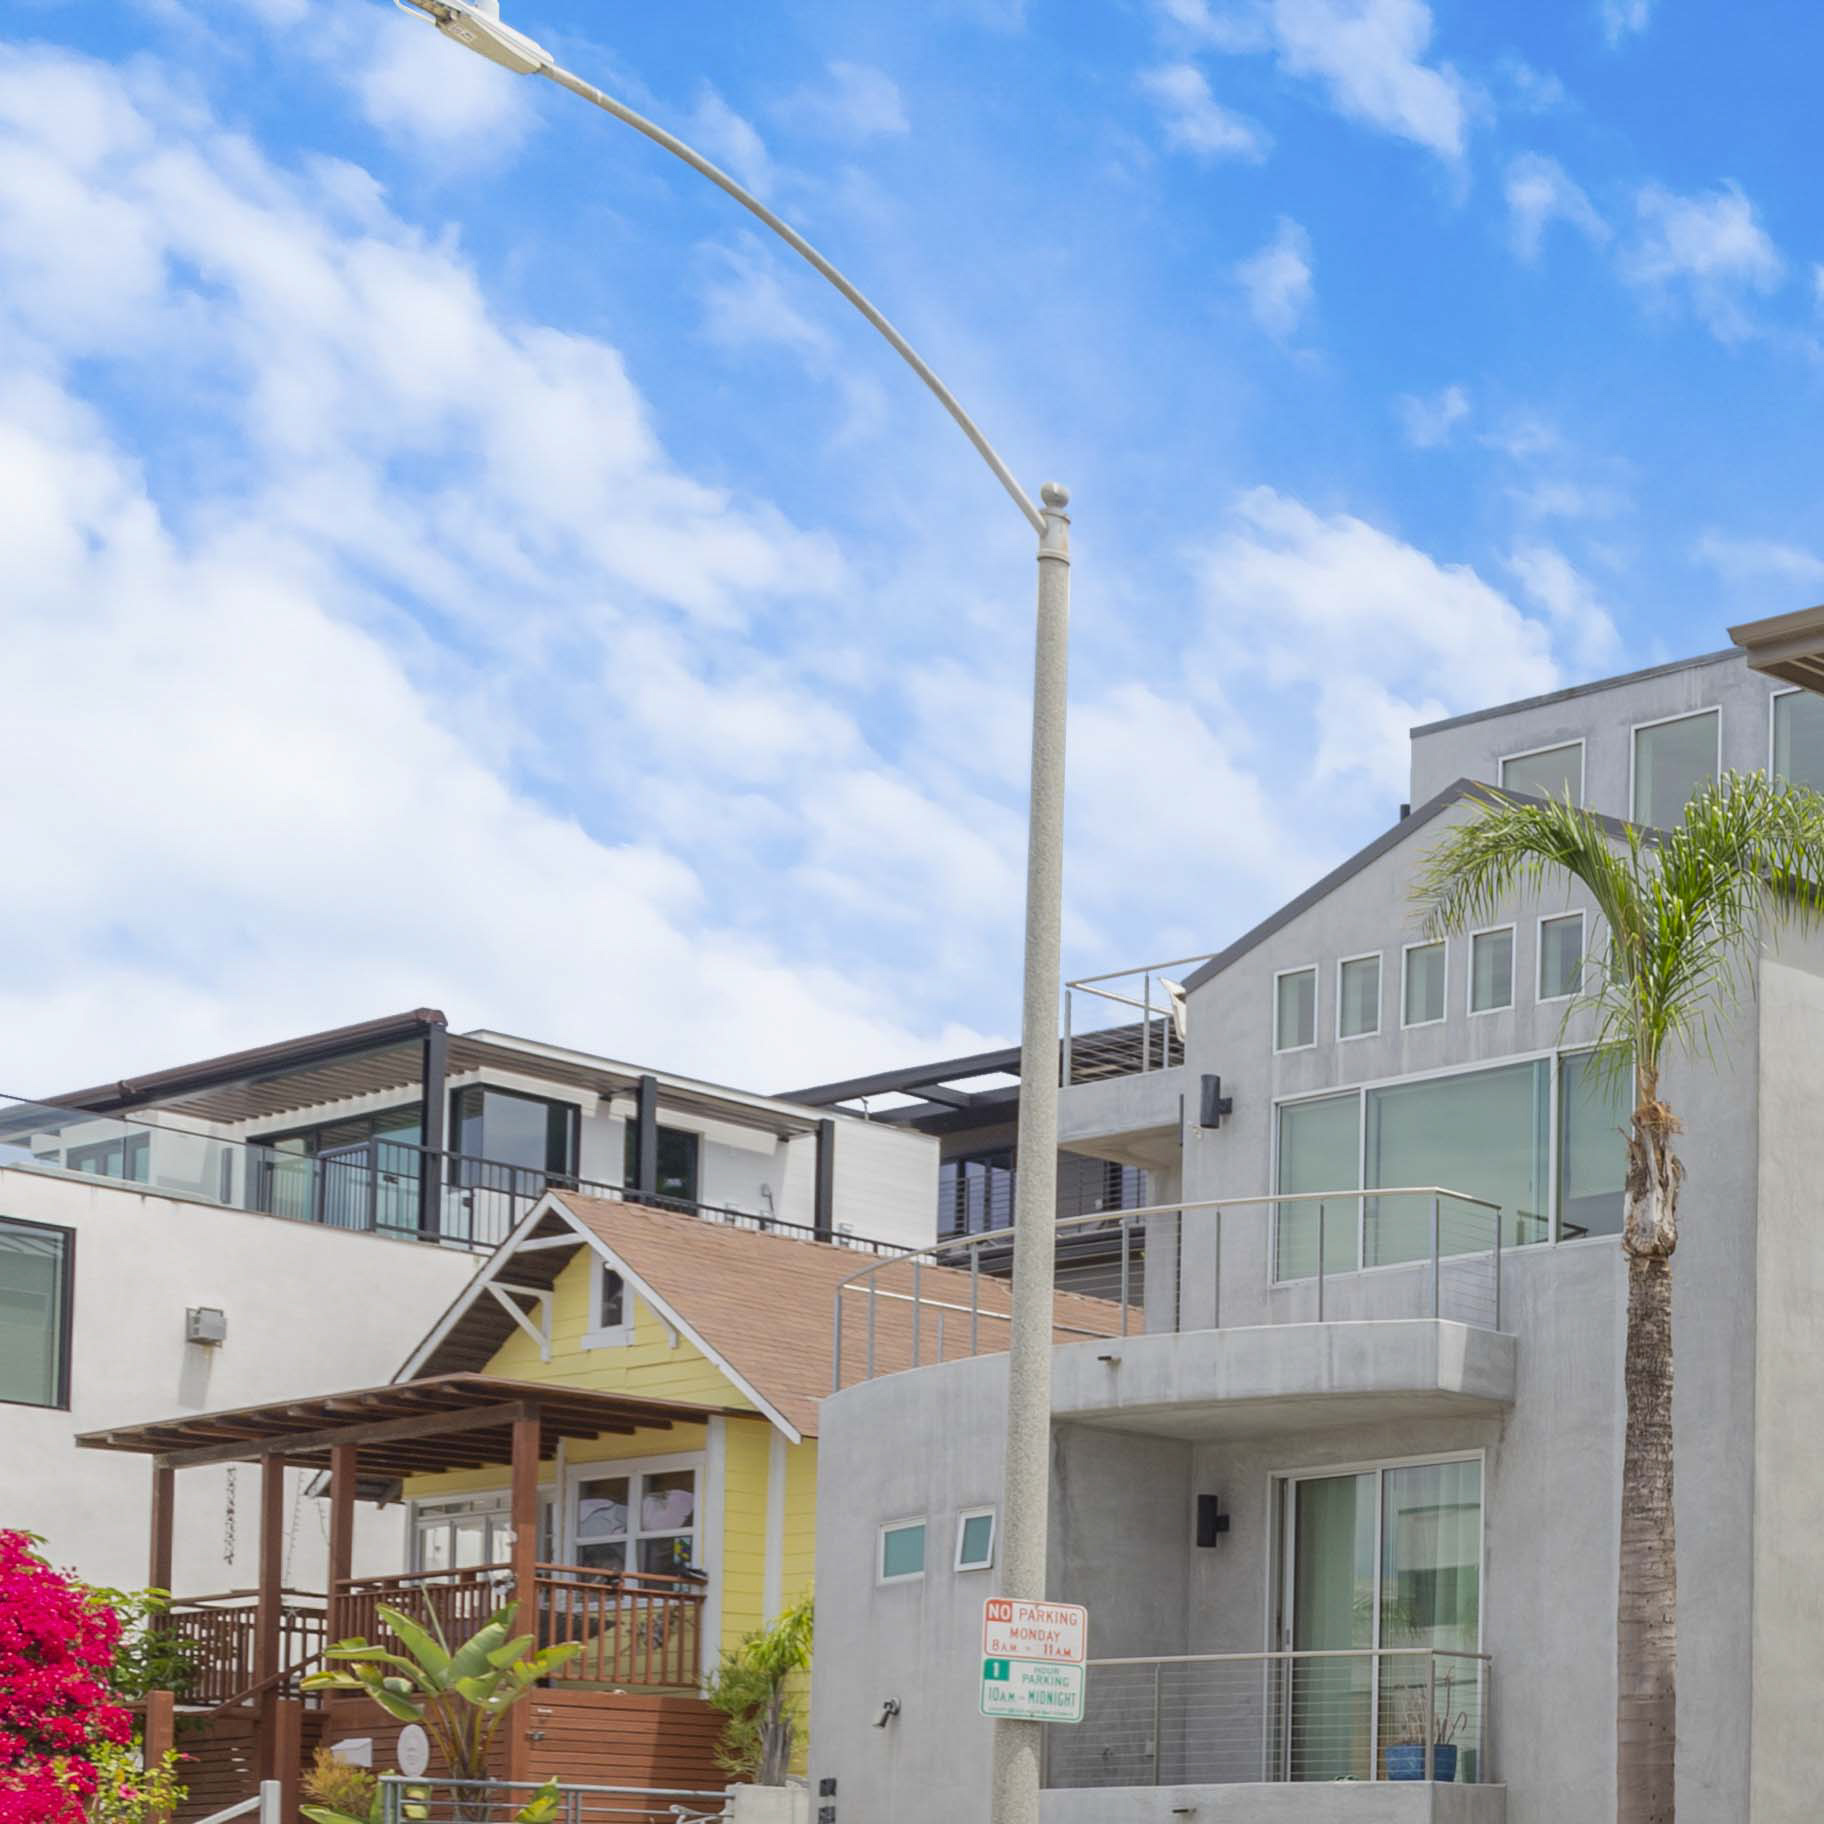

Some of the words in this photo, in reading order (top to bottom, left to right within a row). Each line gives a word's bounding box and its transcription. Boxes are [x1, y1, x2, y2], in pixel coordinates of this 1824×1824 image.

[988, 1603, 1011, 1620] NO
[1019, 1608, 1077, 1626] PARKING
[1010, 1627, 1061, 1643] MONDAY
[1043, 1644, 1072, 1657] 11AM
[993, 1661, 1000, 1679] 1
[1022, 1674, 1070, 1688] PARKING
[1027, 1690, 1076, 1707] MIDNIGHT
